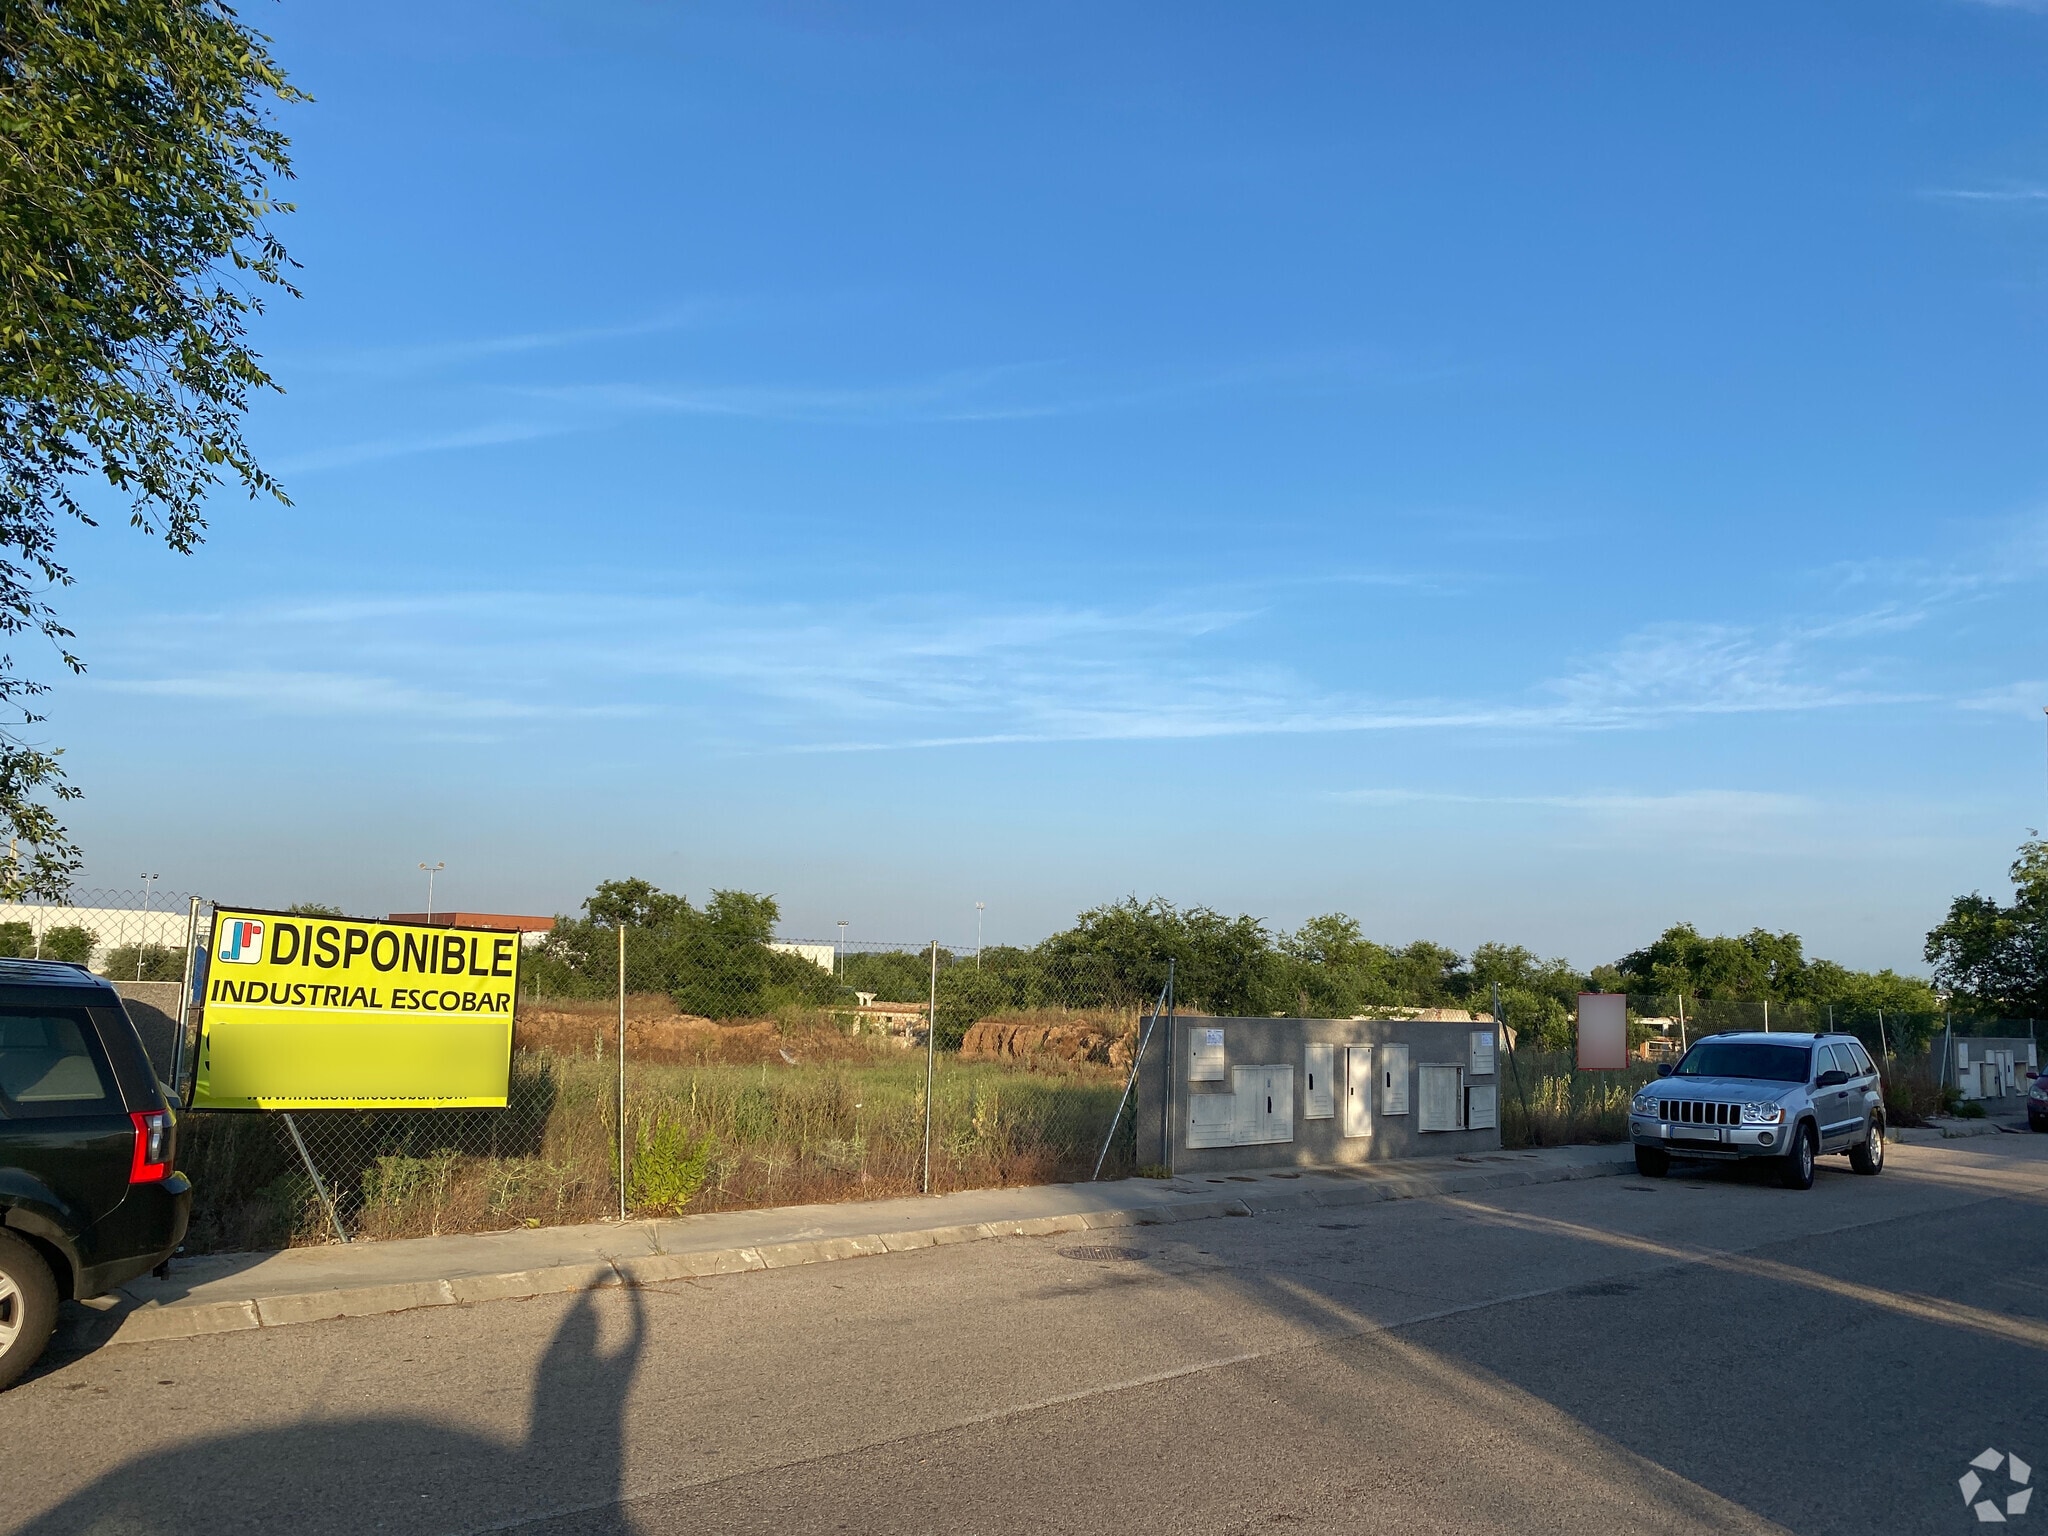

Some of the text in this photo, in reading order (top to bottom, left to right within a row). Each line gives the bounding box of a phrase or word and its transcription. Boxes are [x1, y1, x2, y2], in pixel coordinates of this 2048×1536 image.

[270, 923, 513, 977] DISPONIBLE
[211, 980, 510, 1012] INDUSTRIAL ESCOBAR
